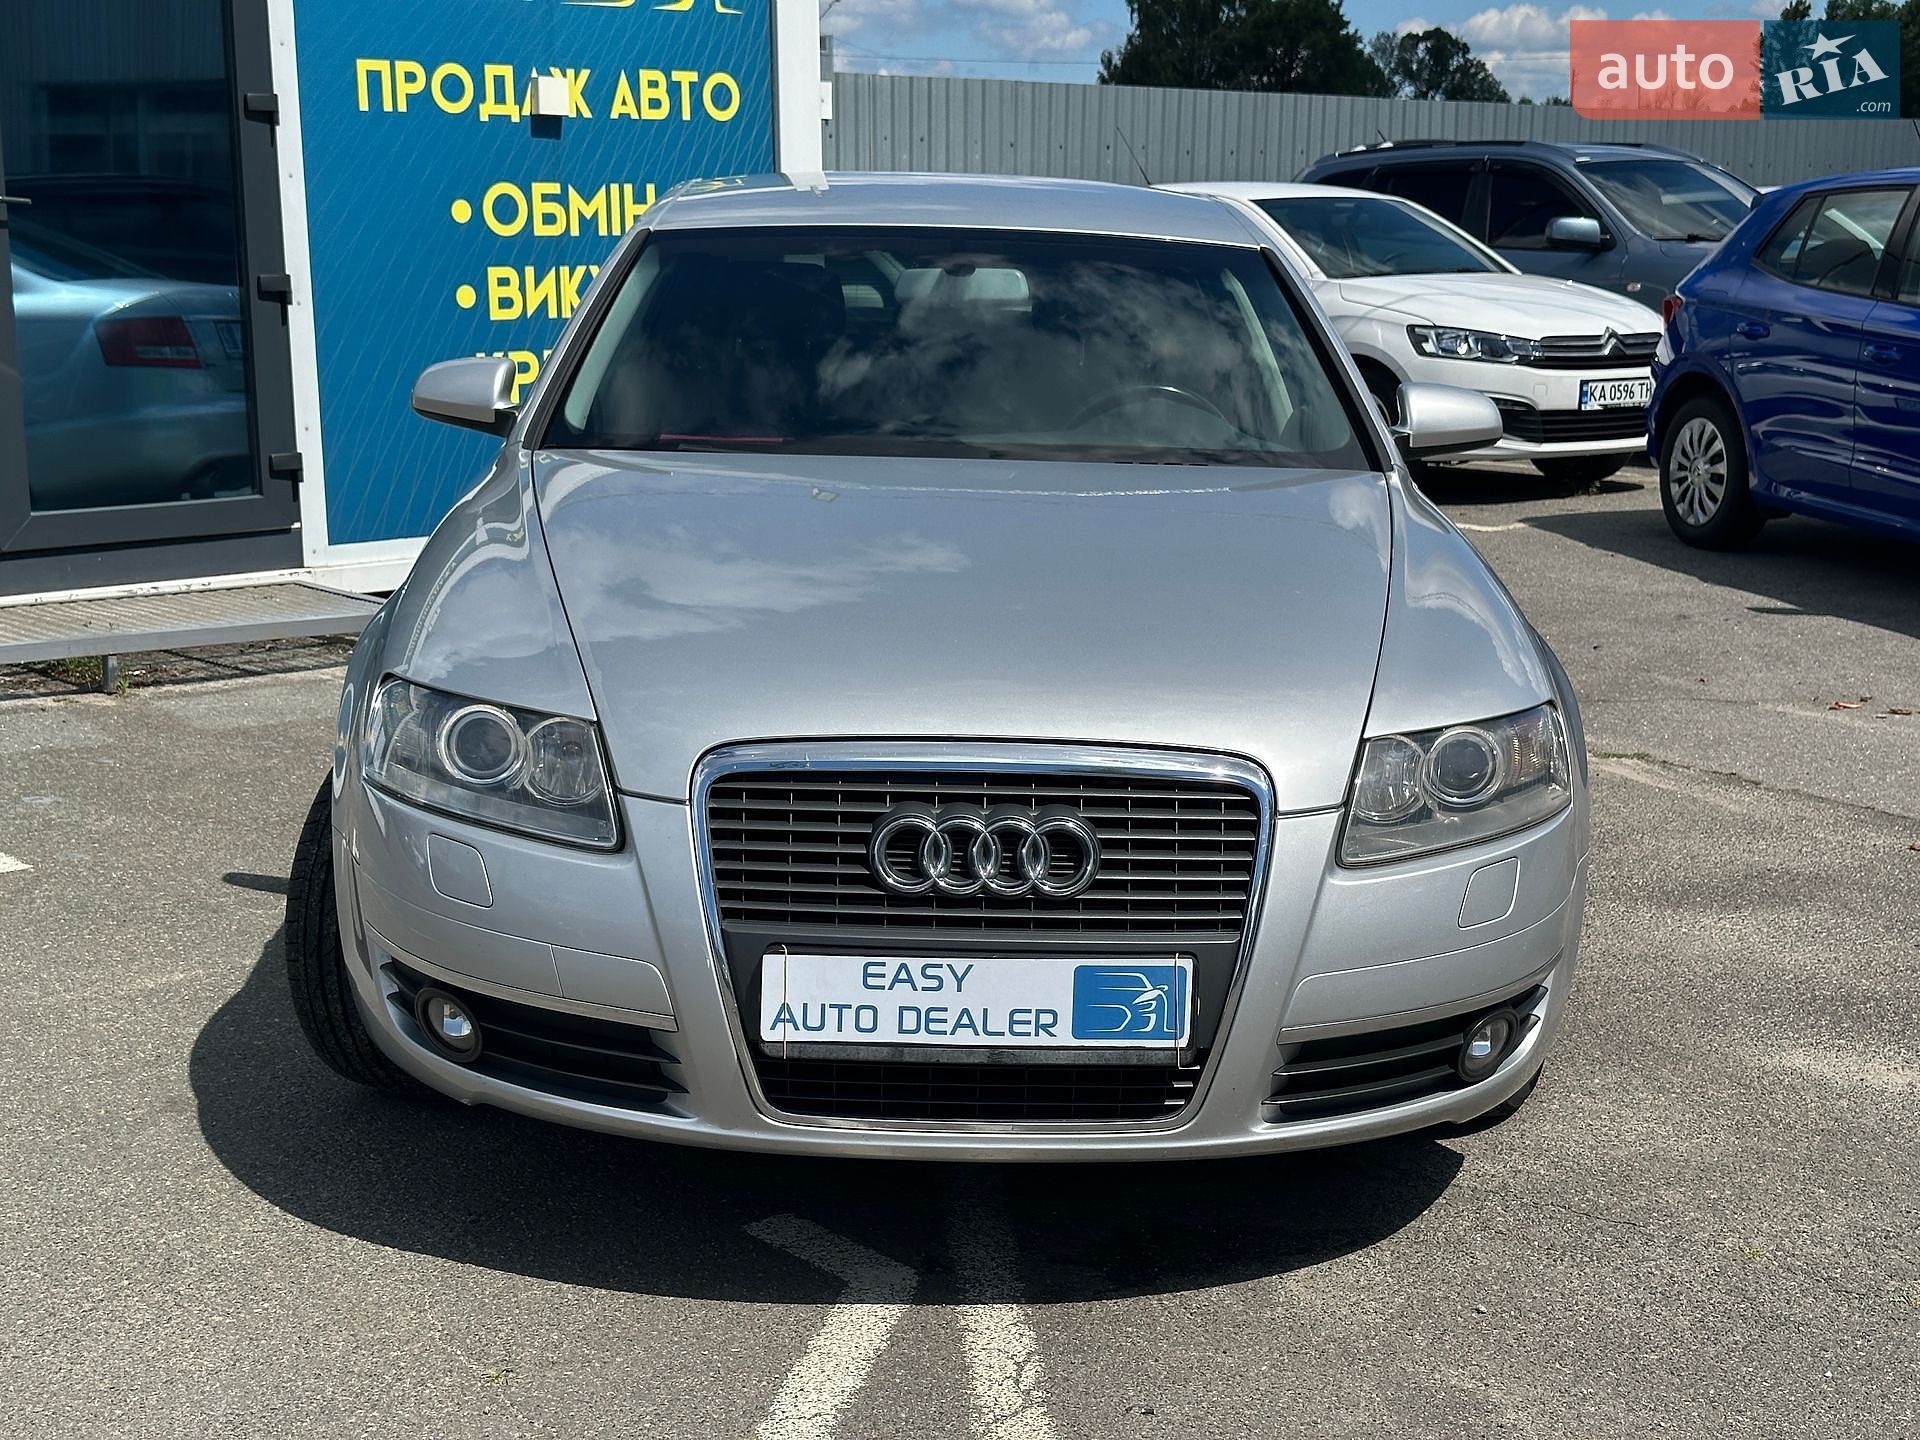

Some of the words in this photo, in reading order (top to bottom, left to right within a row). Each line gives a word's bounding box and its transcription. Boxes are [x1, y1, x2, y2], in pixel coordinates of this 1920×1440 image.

[355, 58, 593, 123] ПРОДЖ
[610, 69, 741, 121] АВТО
[487, 264, 602, 321] ВИК
[1589, 384, 1607, 403] KA
[1609, 383, 1635, 401] 0596
[862, 961, 974, 993] EASY
[769, 1002, 879, 1034] AUTO
[897, 1005, 1059, 1038] DEALER
